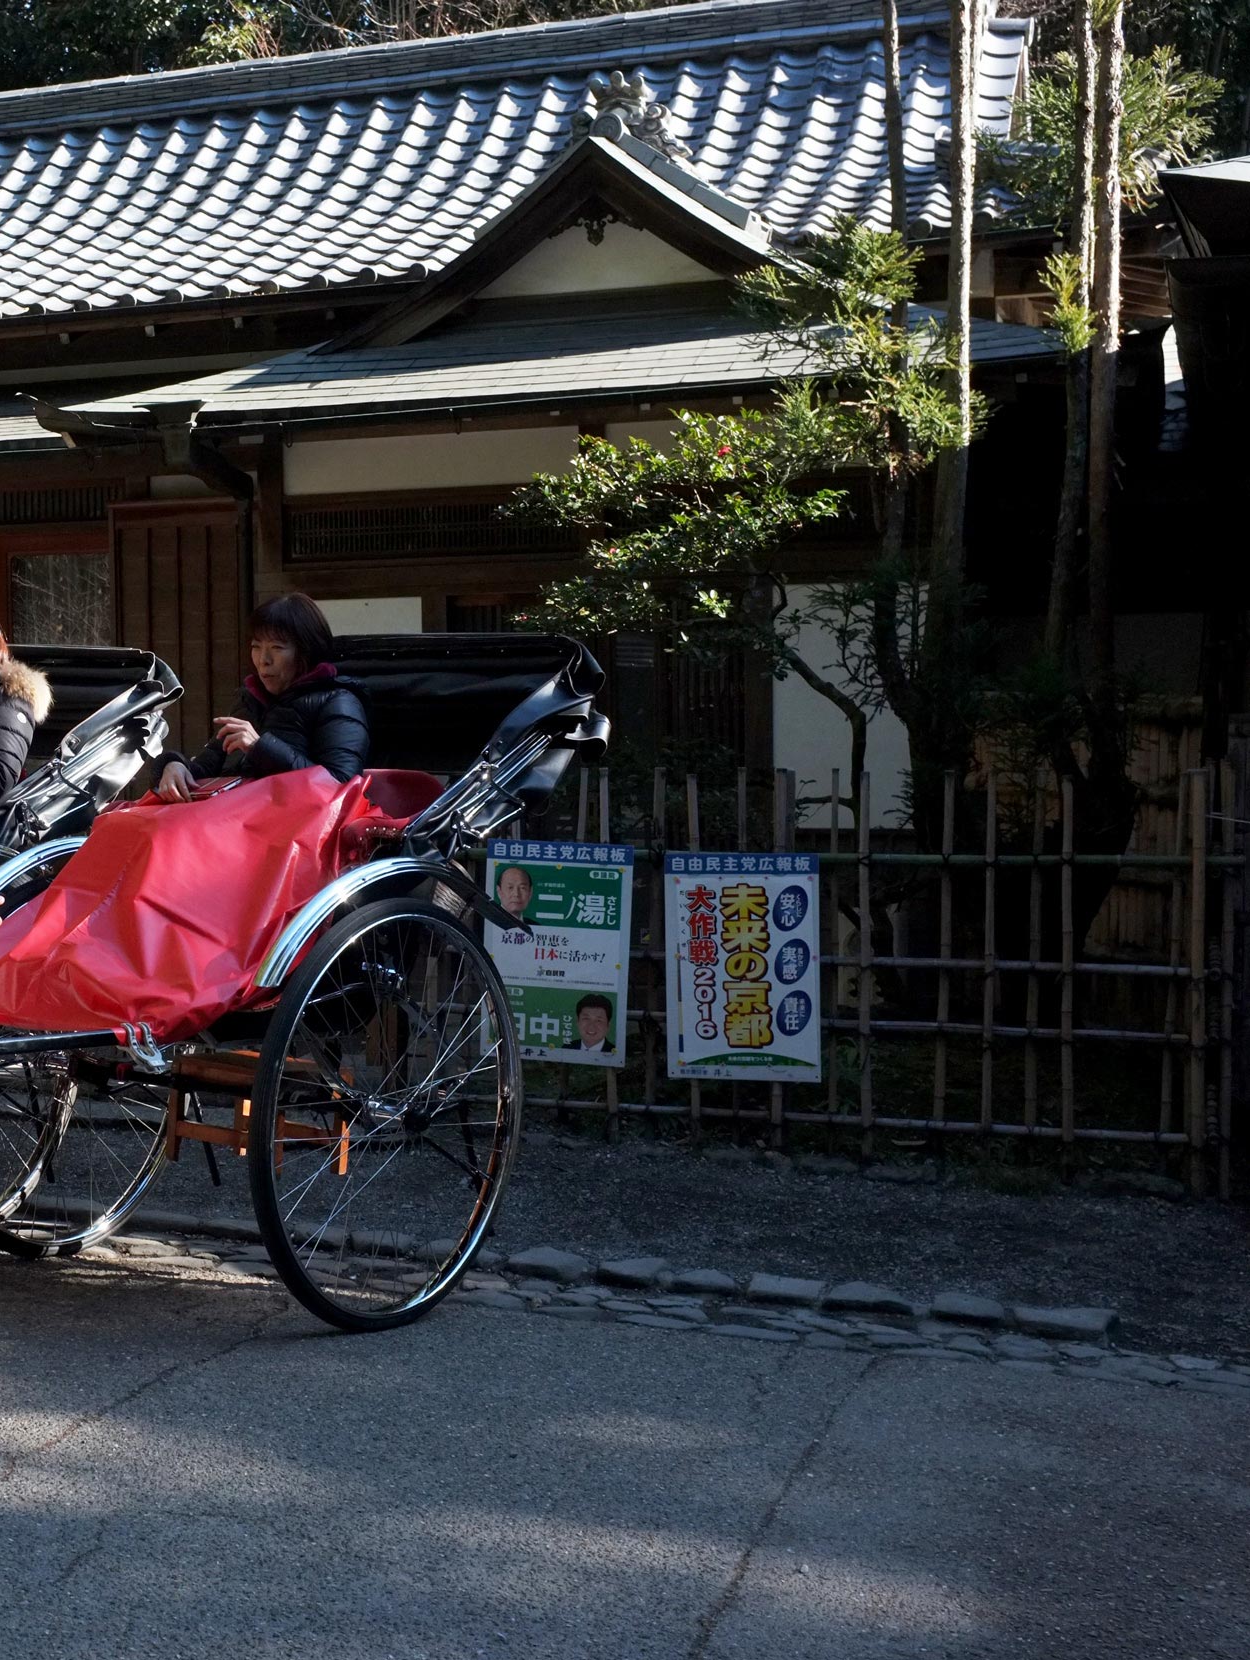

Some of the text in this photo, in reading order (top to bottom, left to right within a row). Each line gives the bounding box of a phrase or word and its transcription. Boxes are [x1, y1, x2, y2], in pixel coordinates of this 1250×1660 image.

[493, 842, 627, 862] 自由民主党広報板
[671, 857, 811, 872] 自由民主党広報板
[535, 893, 606, 925] 二ノ湯
[607, 896, 617, 925] さとし
[780, 893, 795, 927] 安心
[501, 931, 570, 947] 京都の智恵を
[686, 884, 718, 1039] 大作戦2016
[719, 883, 774, 1049] 未来の京都
[782, 946, 798, 980] 実感
[785, 996, 800, 1031] 責任
